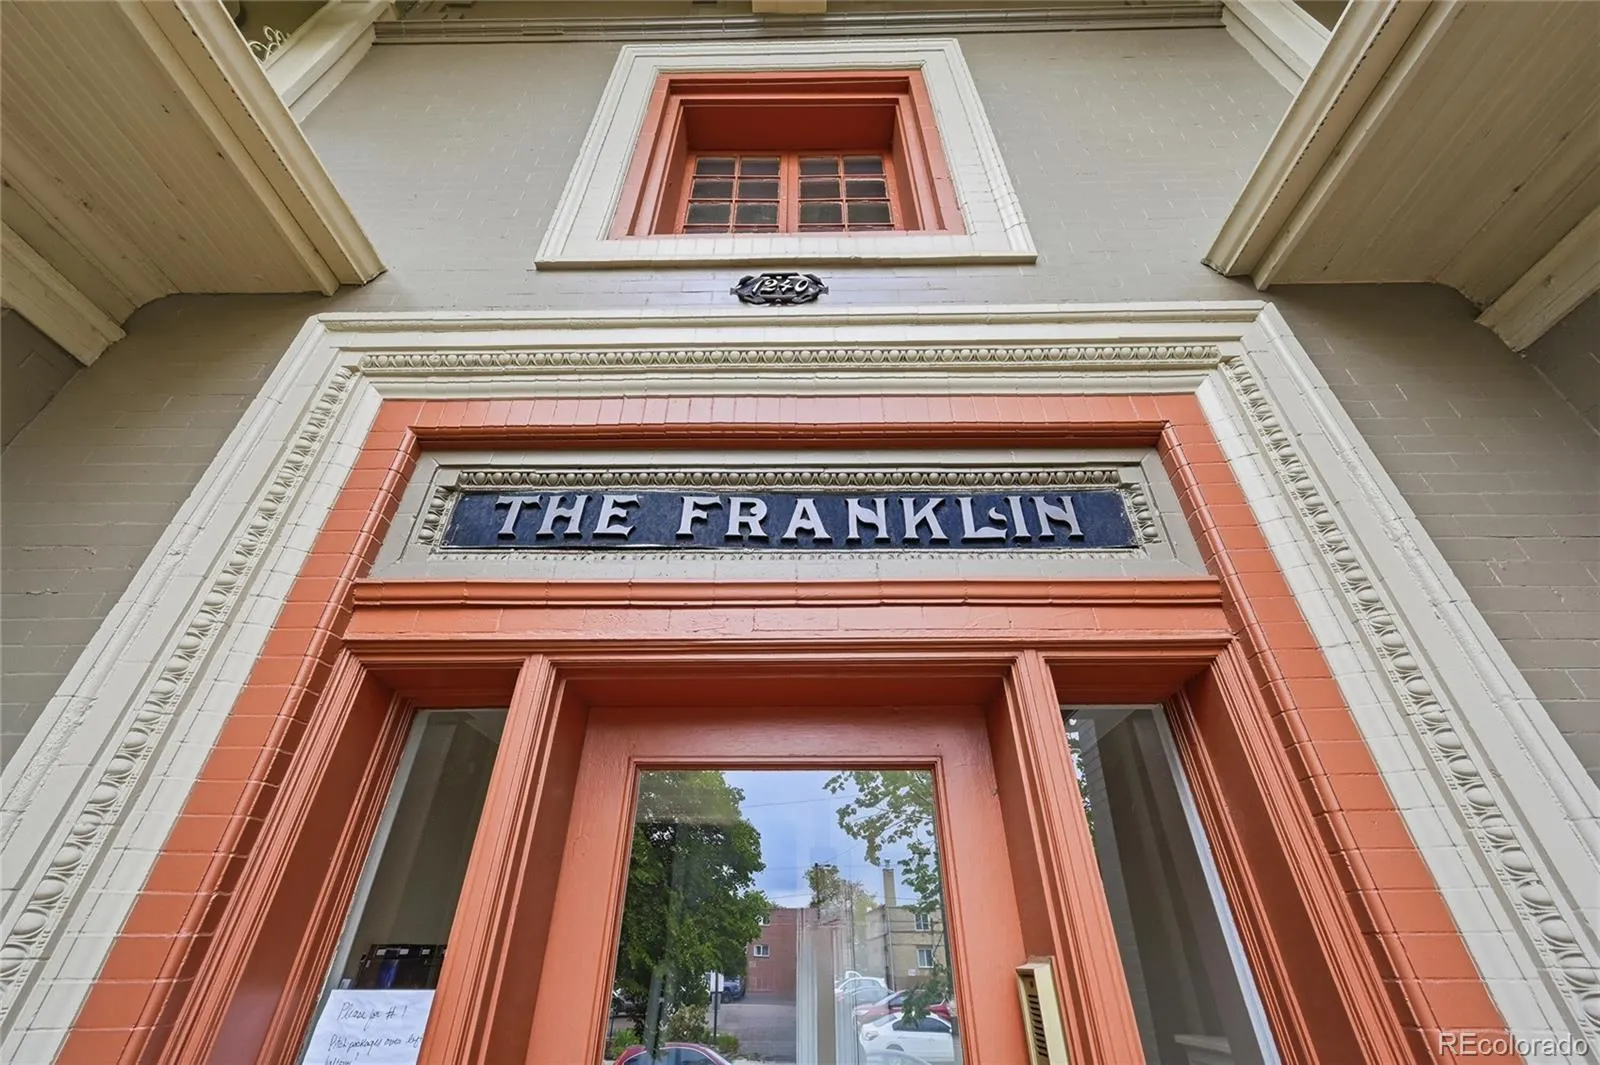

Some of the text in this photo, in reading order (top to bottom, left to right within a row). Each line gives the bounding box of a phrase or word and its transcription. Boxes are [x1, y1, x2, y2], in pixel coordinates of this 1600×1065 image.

[751, 278, 809, 294] 1240
[495, 494, 1086, 543] THE FRANKLIN
